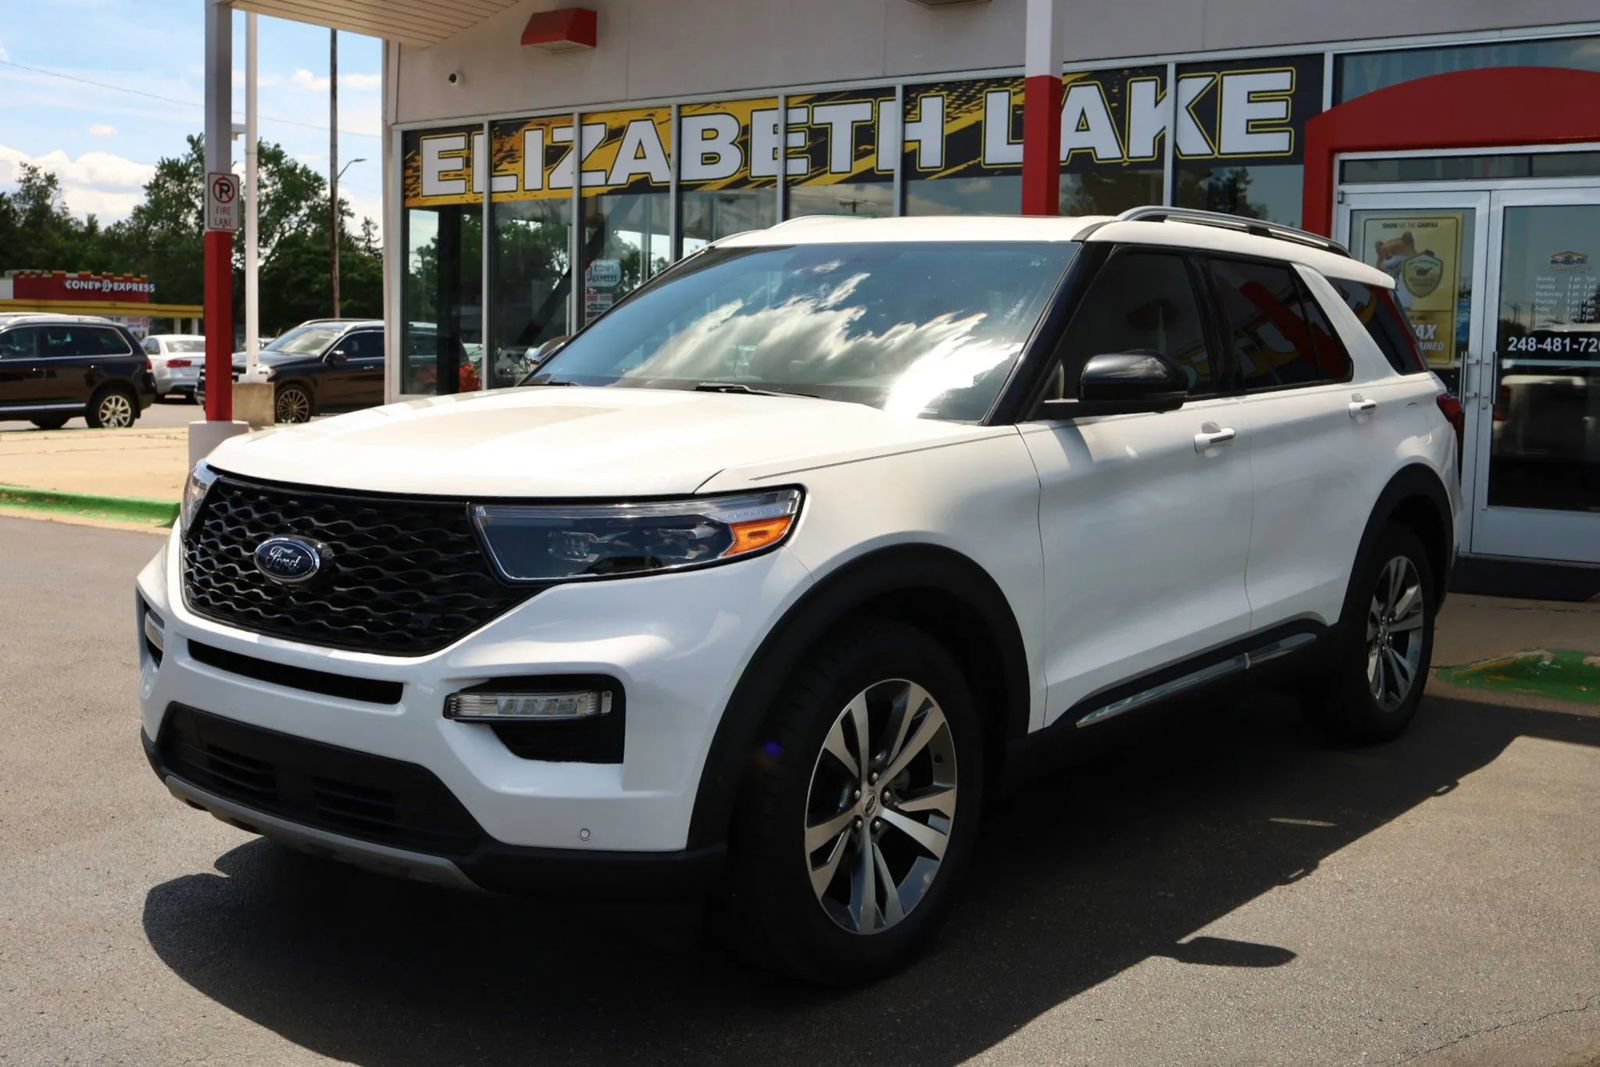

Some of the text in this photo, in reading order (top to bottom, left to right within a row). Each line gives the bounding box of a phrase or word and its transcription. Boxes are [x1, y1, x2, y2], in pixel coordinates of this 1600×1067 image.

[421, 69, 1294, 197] ELIZABETH LAKE
[216, 205, 231, 215] FIRE
[214, 217, 233, 227] LANE
[65, 280, 156, 293] CONEY EXPRESS
[1507, 336, 1600, 352] 248-481-72
[266, 545, 302, 568] Ford
